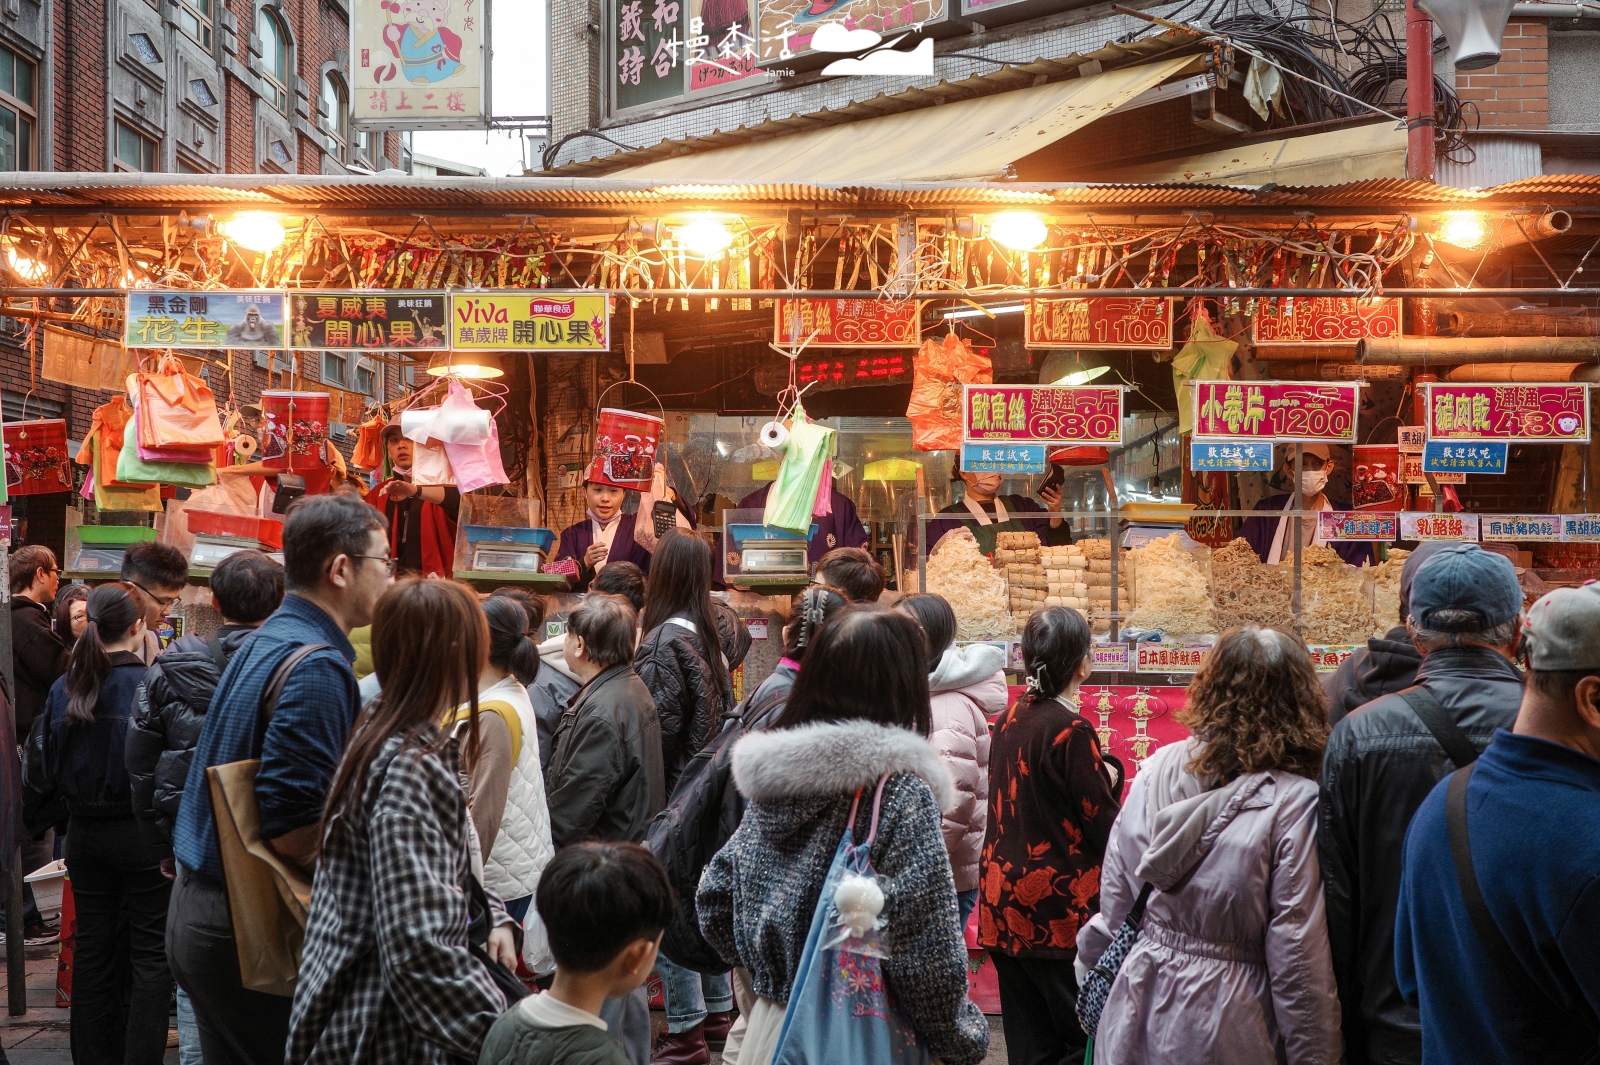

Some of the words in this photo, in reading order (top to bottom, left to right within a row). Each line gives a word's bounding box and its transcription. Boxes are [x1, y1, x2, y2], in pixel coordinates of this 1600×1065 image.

[369, 89, 467, 113] 請上二樓
[147, 295, 208, 315] 黑金剛
[315, 296, 388, 320] 夏威夷
[533, 304, 571, 314] 聯華食品
[136, 315, 219, 344] 花生
[324, 320, 418, 347] 開心果
[459, 327, 508, 344] 萬歲牌
[512, 320, 594, 346] 開心果
[972, 392, 1026, 431] 魷魚絲
[1031, 389, 1119, 414] 通通一斤
[1201, 385, 1266, 435] 小卷片
[1494, 387, 1584, 412] 通通一斤
[1435, 393, 1491, 431] 豬肉乾
[982, 449, 1031, 461] 歡迎試吃
[1207, 446, 1256, 458] 歡迎試吃
[1442, 447, 1491, 459] 歡迎試吃
[1416, 518, 1463, 536] 乳酪絲
[1490, 522, 1553, 536] 原味豬肉乾
